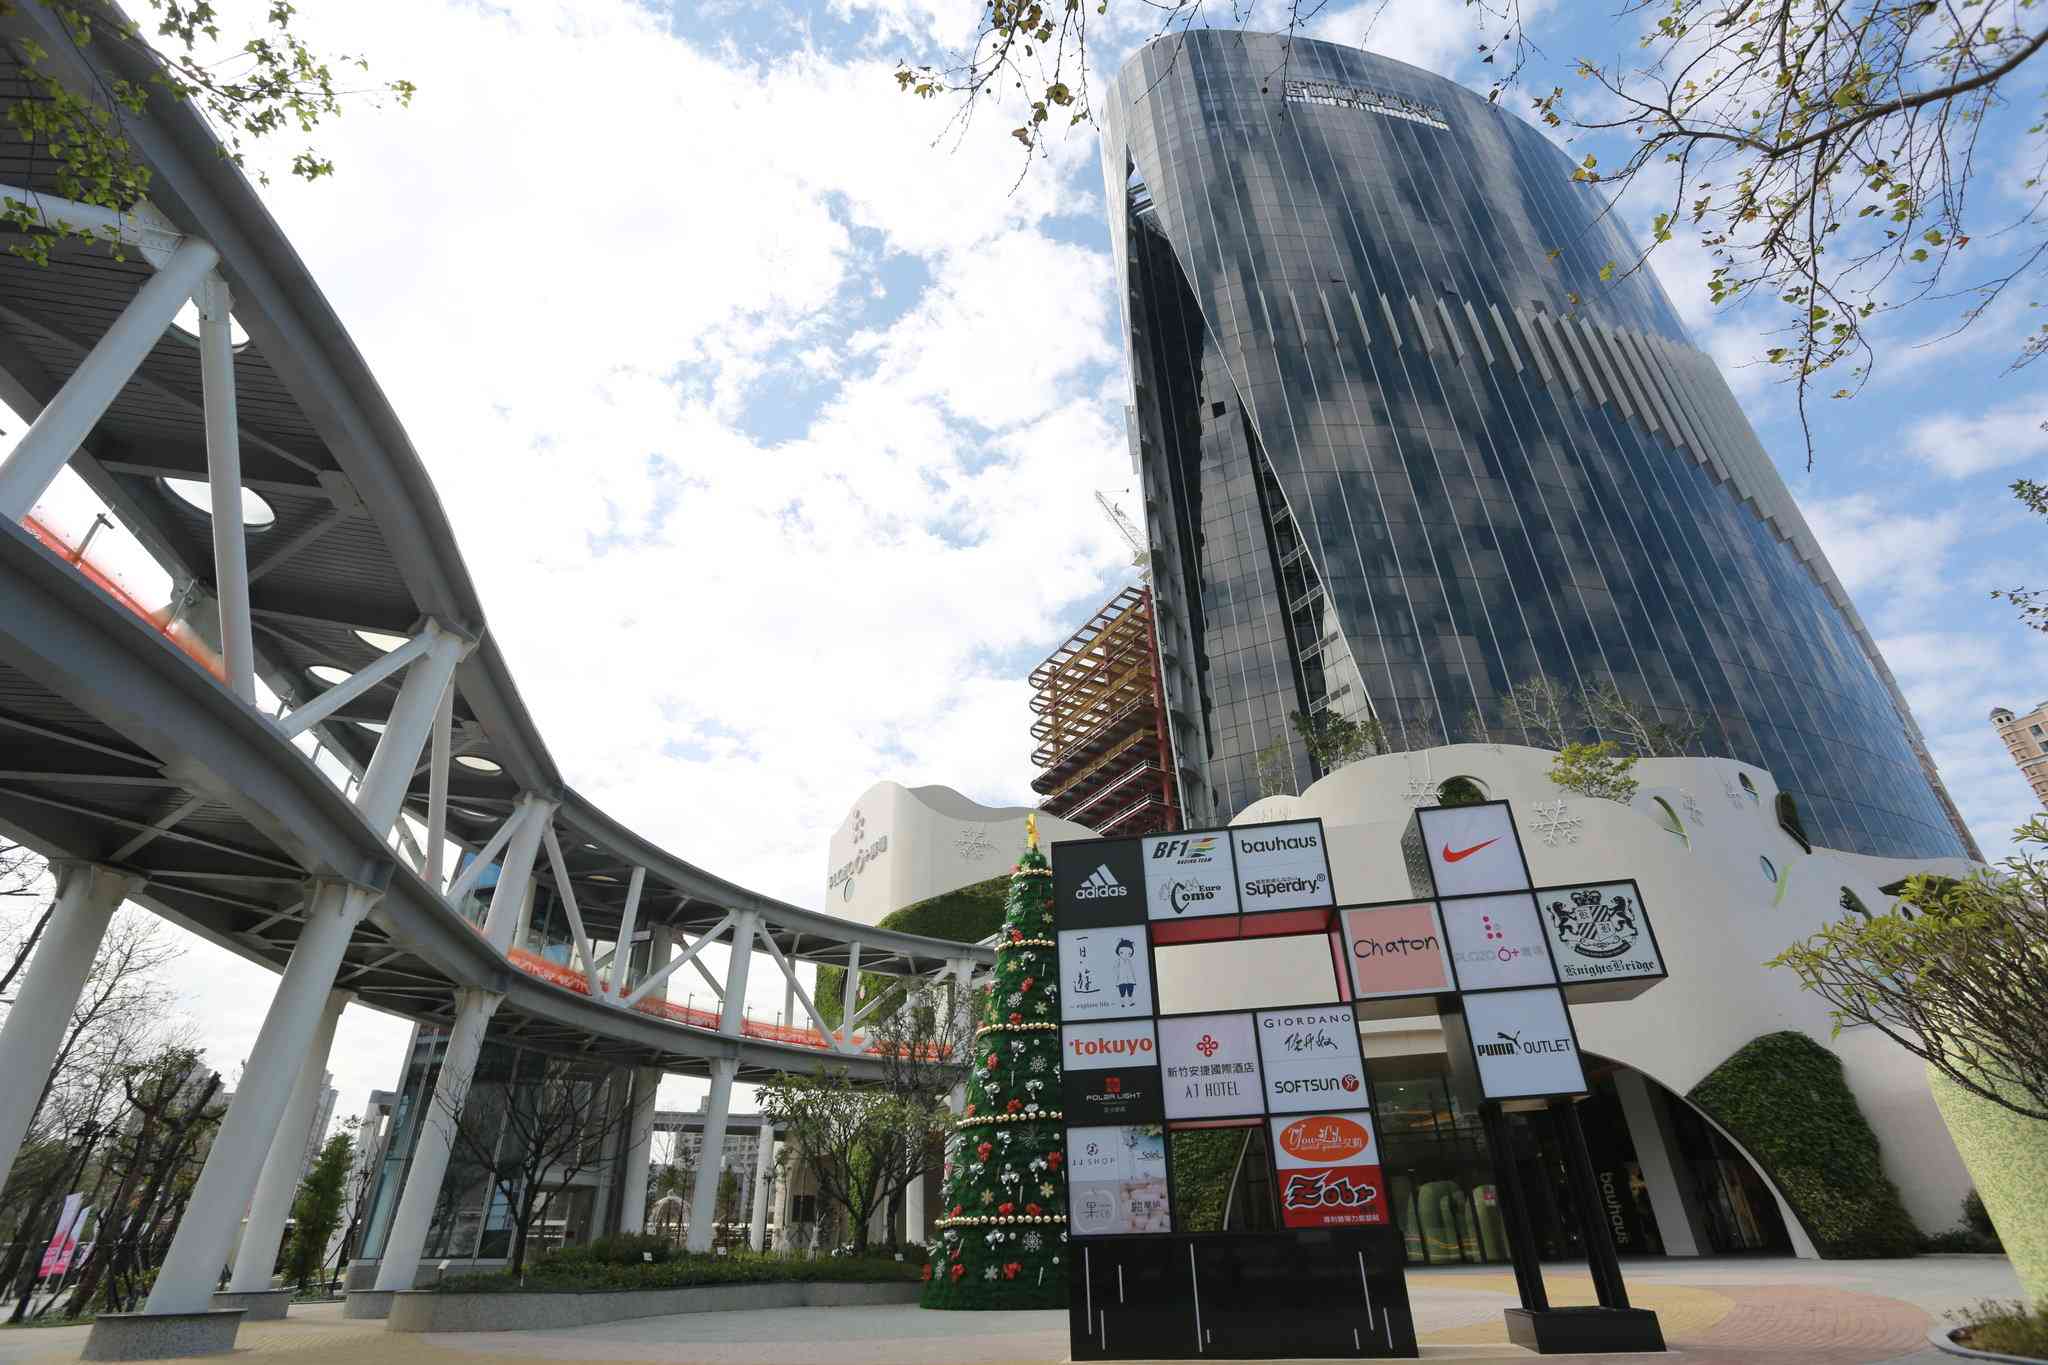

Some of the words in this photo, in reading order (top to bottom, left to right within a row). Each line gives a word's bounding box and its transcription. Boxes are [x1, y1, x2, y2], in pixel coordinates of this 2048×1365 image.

[1152, 839, 1190, 859] BF1
[1241, 836, 1317, 854] bauhaus
[1075, 884, 1127, 900] adidas
[1353, 935, 1440, 959] Chaton
[1563, 959, 1656, 977] KnightsBridge
[1263, 1014, 1351, 1028] GIORDANO
[1074, 1038, 1153, 1056] tokuyo
[1477, 1043, 1515, 1057] PUMA
[1522, 1039, 1571, 1055] OUTLET
[1205, 1081, 1241, 1097] HOTEL
